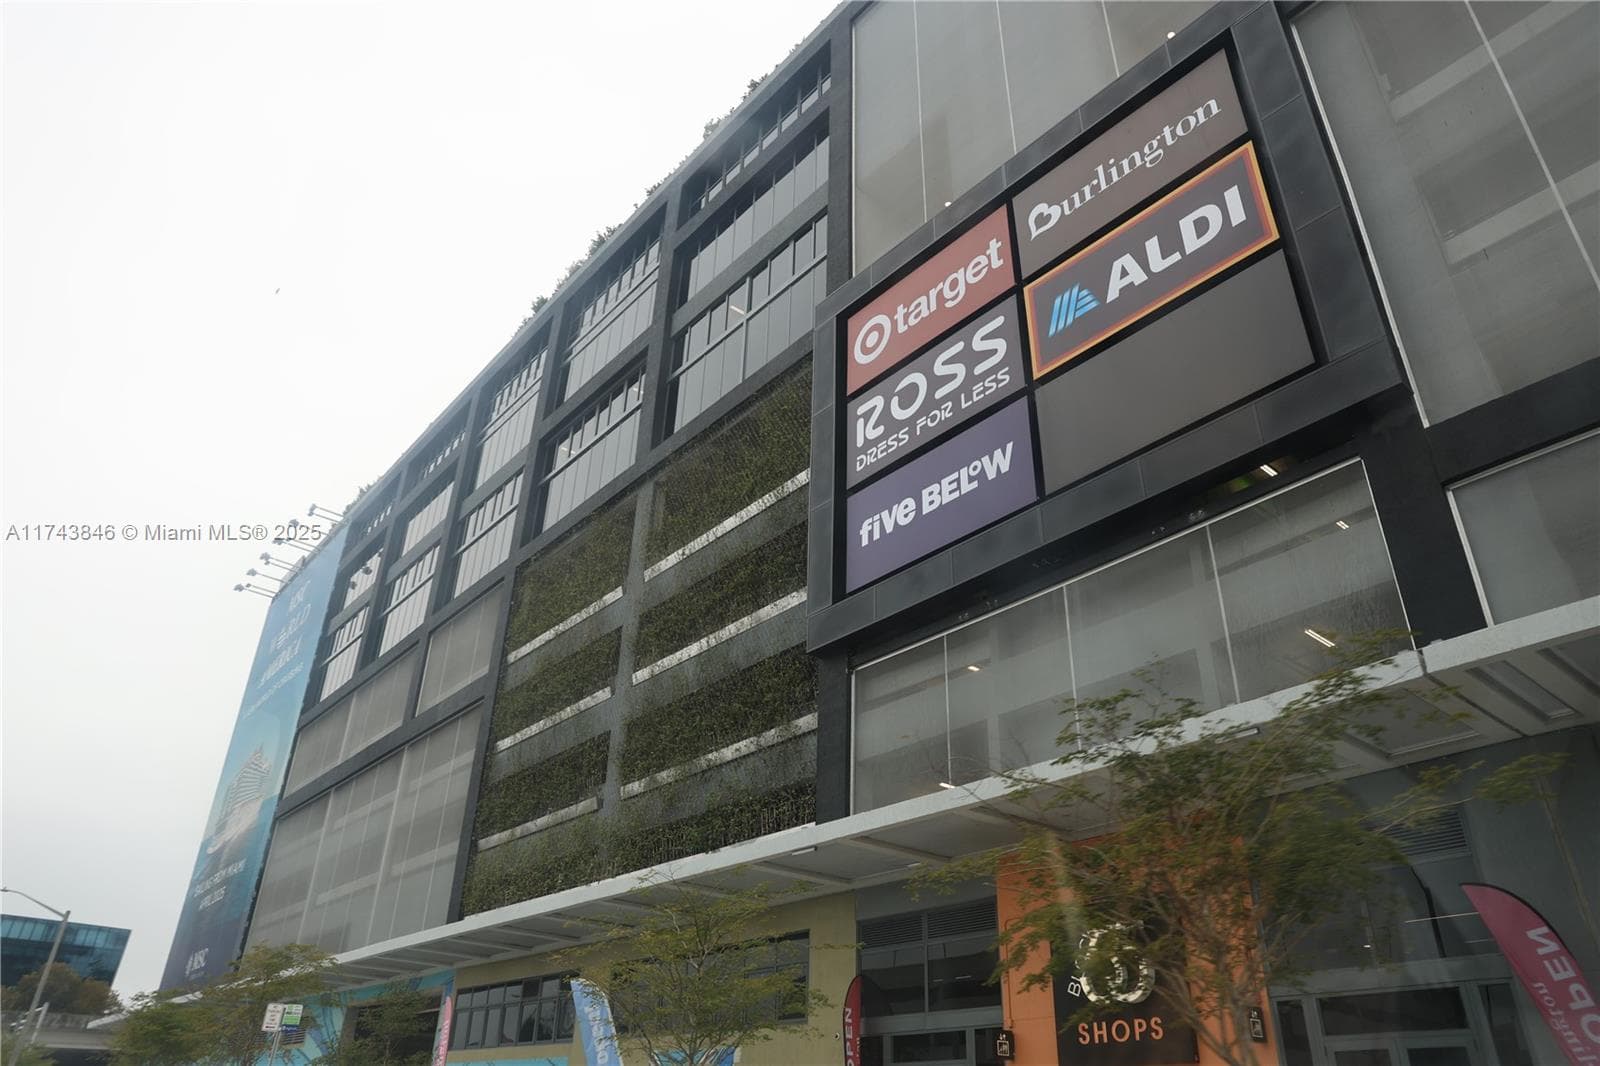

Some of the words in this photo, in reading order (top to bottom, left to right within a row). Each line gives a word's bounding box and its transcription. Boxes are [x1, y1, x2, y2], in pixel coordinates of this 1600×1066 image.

[1027, 96, 1223, 241] Burlington
[894, 235, 1005, 335] target
[1105, 184, 1248, 304] ALDI
[855, 315, 1007, 448] ROSS
[855, 426, 910, 472] DRESS
[916, 403, 953, 436] FOR
[960, 368, 1010, 409] LESS
[859, 496, 917, 548] five
[1078, 1016, 1164, 1045] SHOPS
